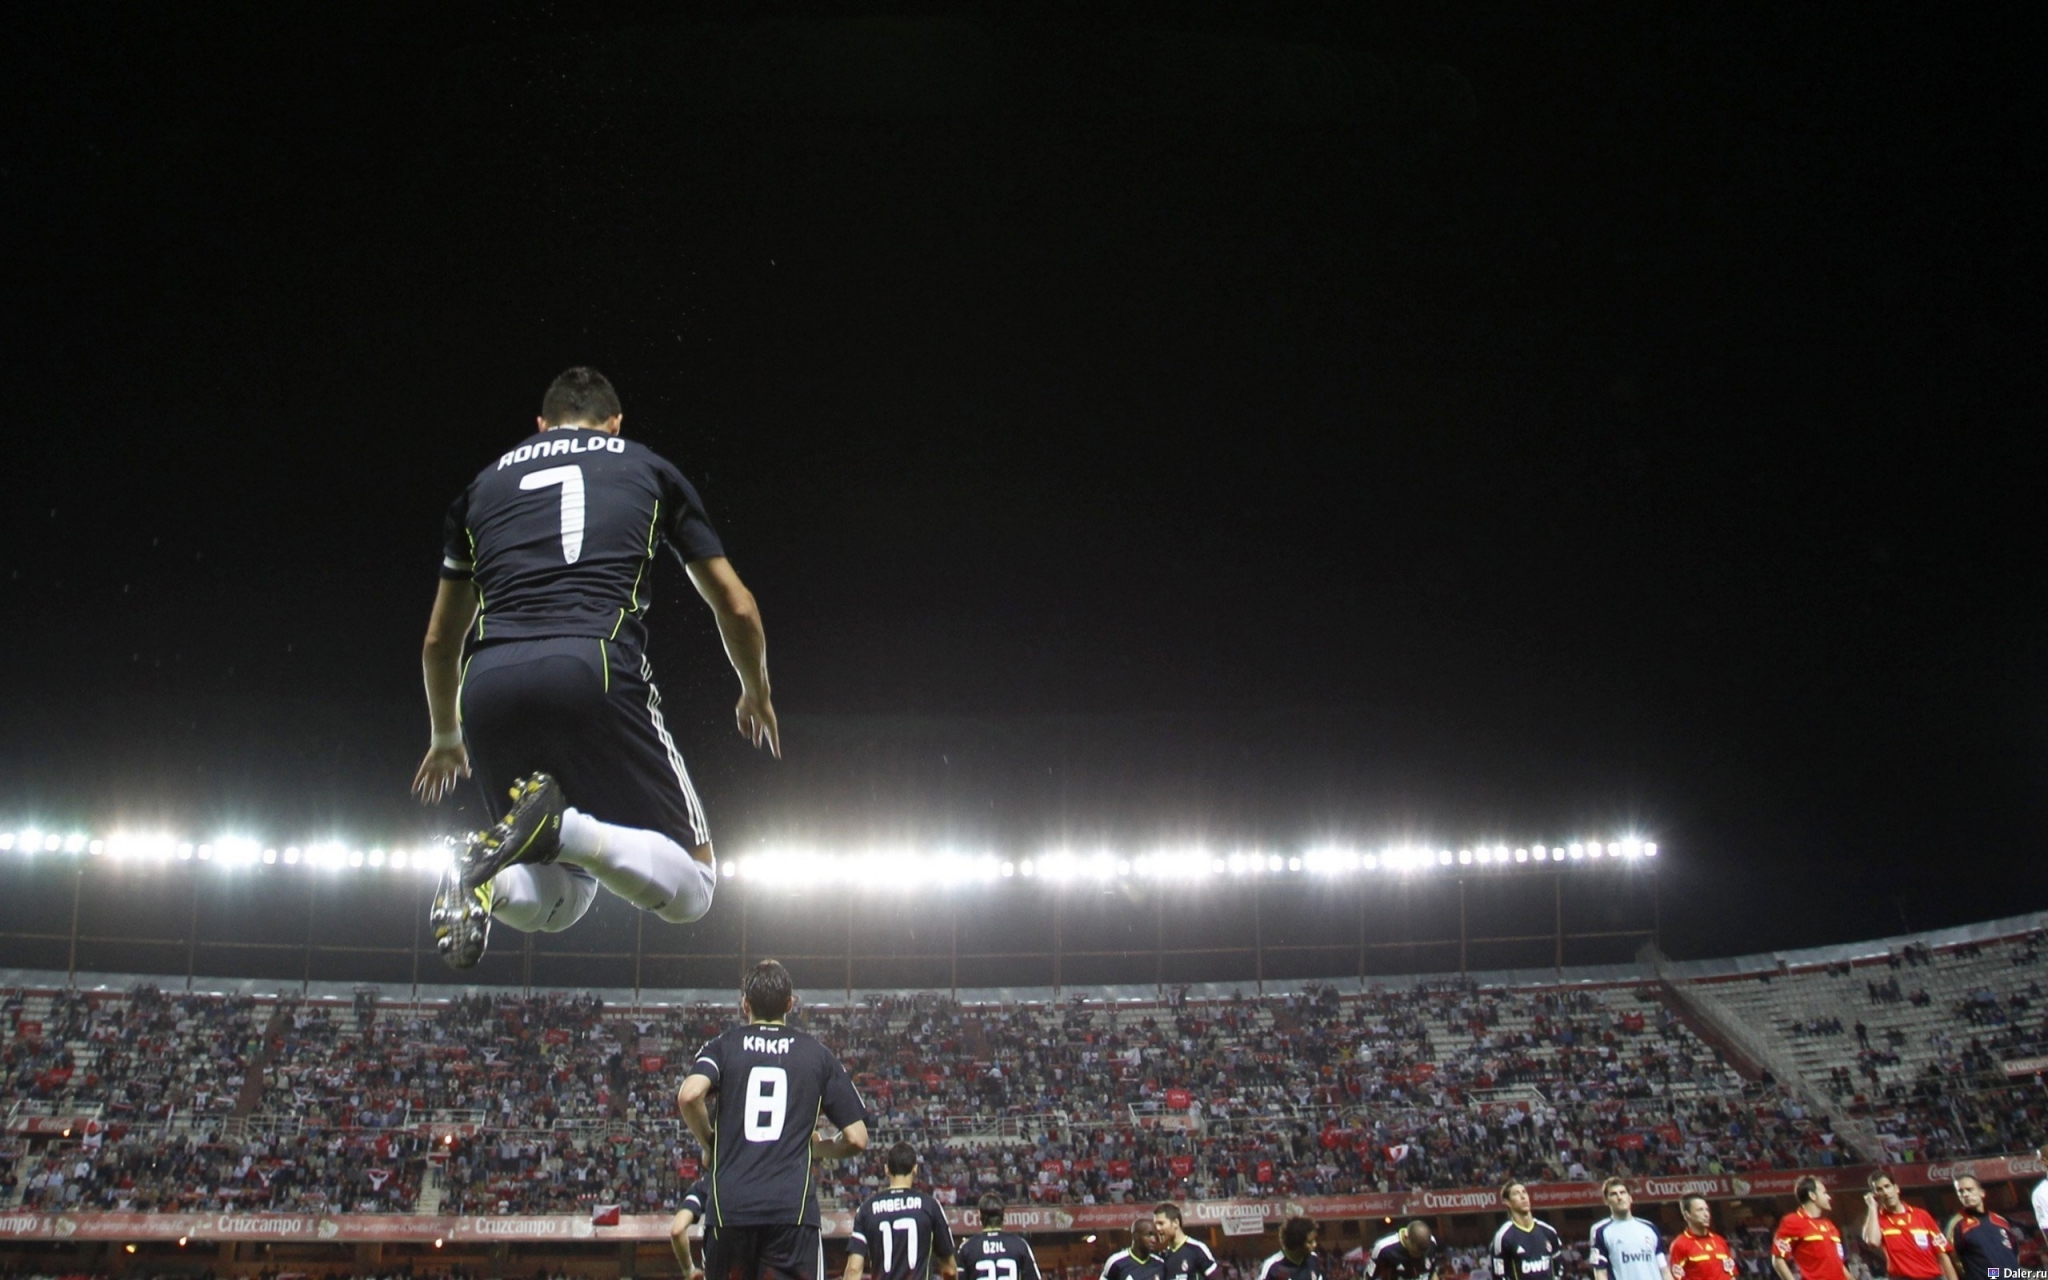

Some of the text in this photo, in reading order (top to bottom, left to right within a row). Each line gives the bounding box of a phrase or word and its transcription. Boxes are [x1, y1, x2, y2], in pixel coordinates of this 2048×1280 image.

[497, 436, 625, 471] RONALDO
[519, 464, 585, 564] 7
[744, 1066, 788, 1142] 8
[1645, 1179, 1718, 1196] Cruzcampo
[872, 1196, 922, 1215] ARBELOA
[1423, 1192, 1497, 1208] Cruzcampo
[218, 1215, 302, 1236] Cruzcampo
[475, 1217, 556, 1237] Cruzcampo
[879, 1217, 918, 1273] 17
[1621, 1251, 1653, 1264] bwin
